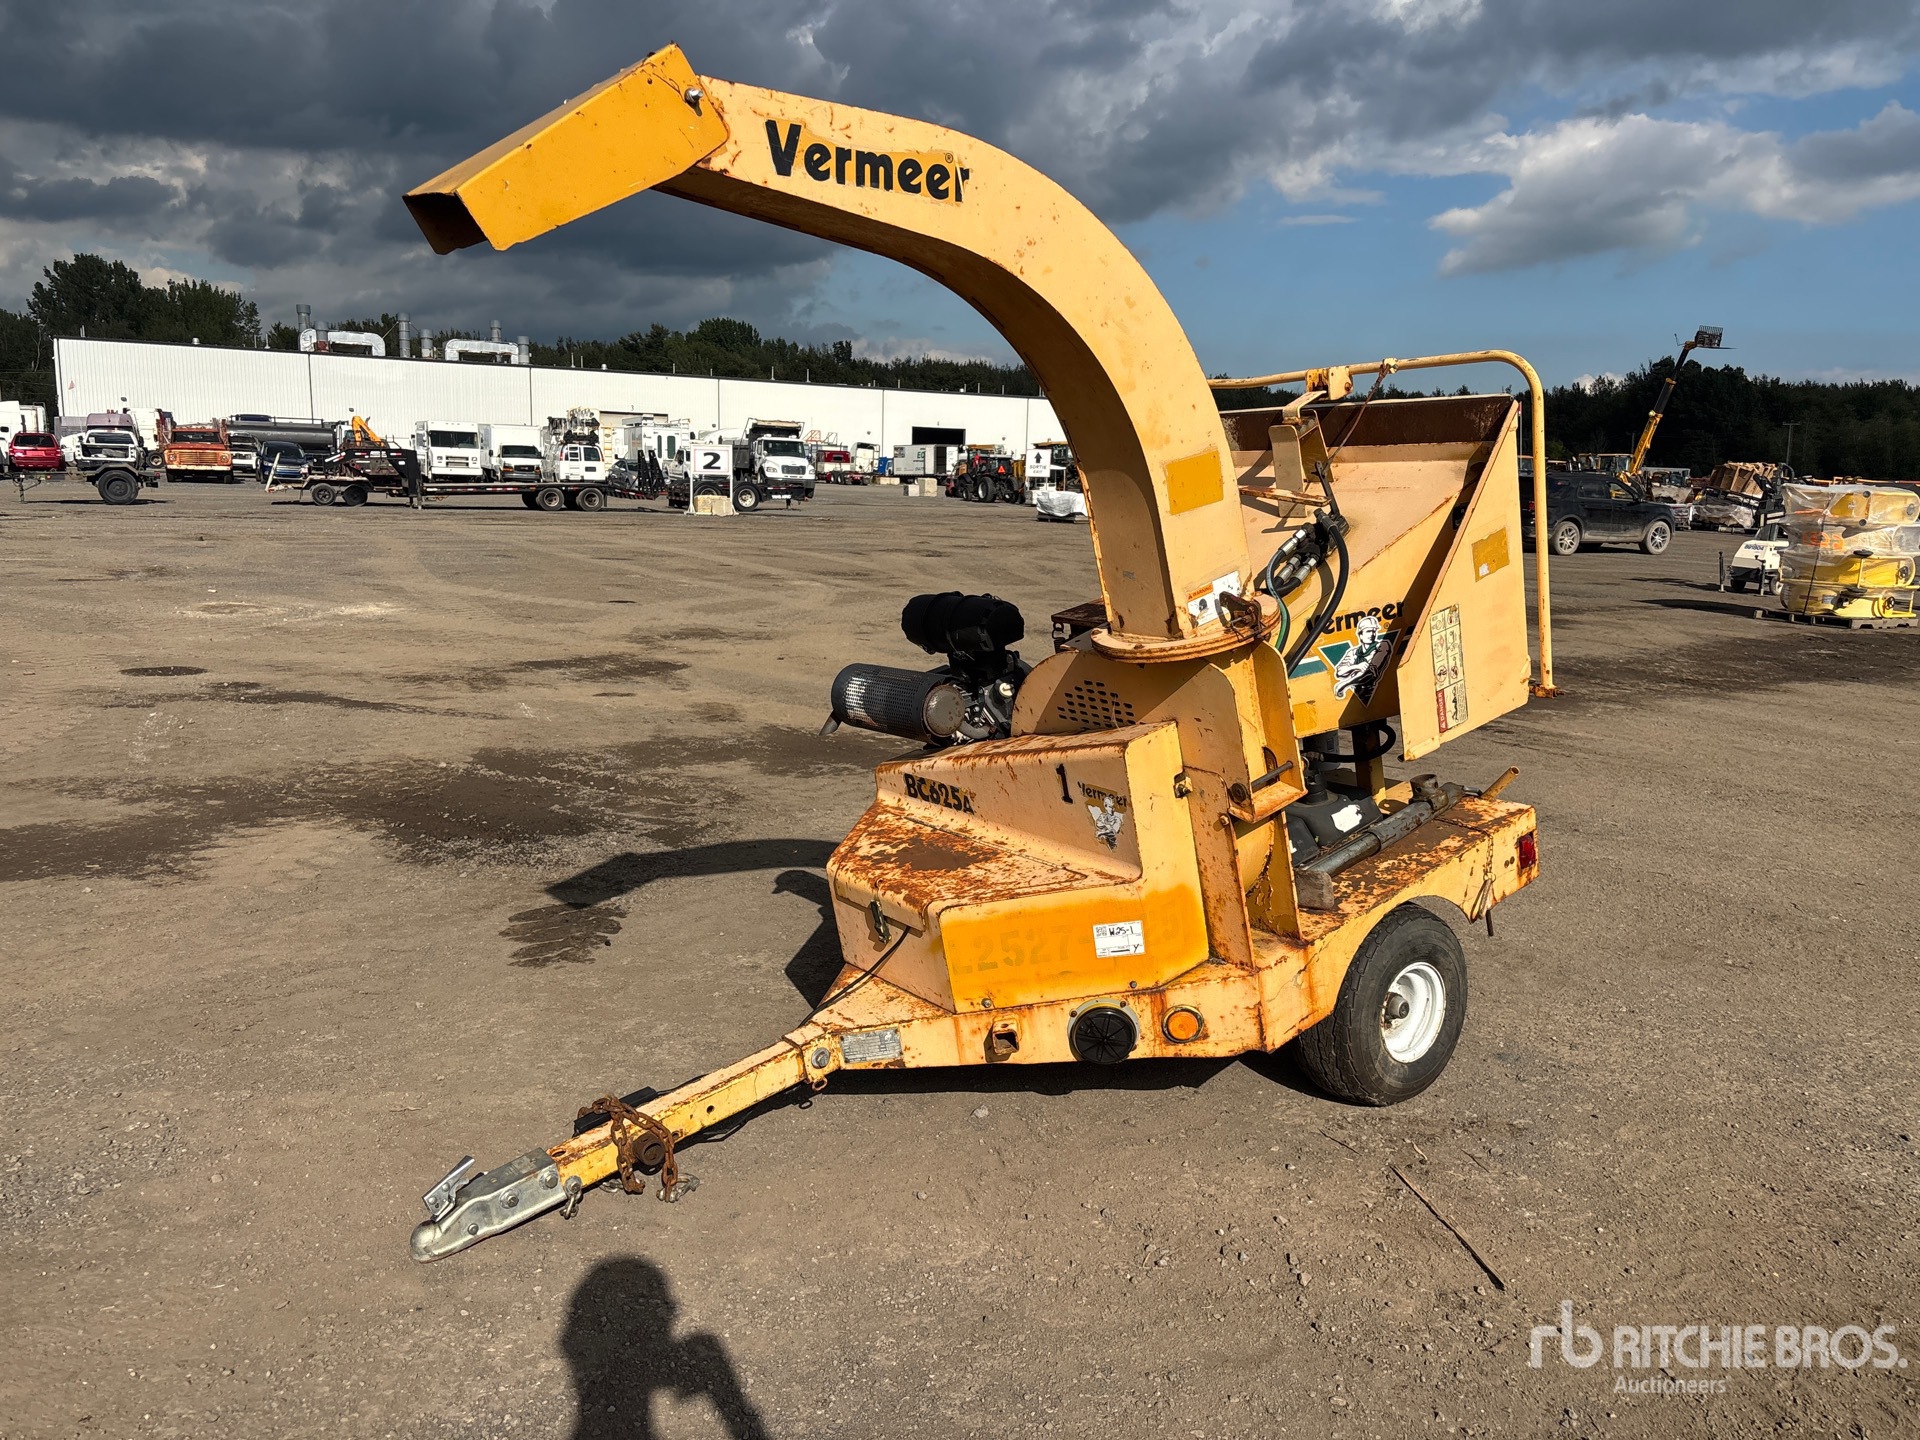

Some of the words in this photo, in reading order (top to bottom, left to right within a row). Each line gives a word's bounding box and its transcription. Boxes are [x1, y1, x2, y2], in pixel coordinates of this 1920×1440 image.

[765, 119, 970, 203] Vermeer
[702, 452, 722, 470] 2
[903, 773, 975, 815] BC625A
[1055, 763, 1074, 804] 1
